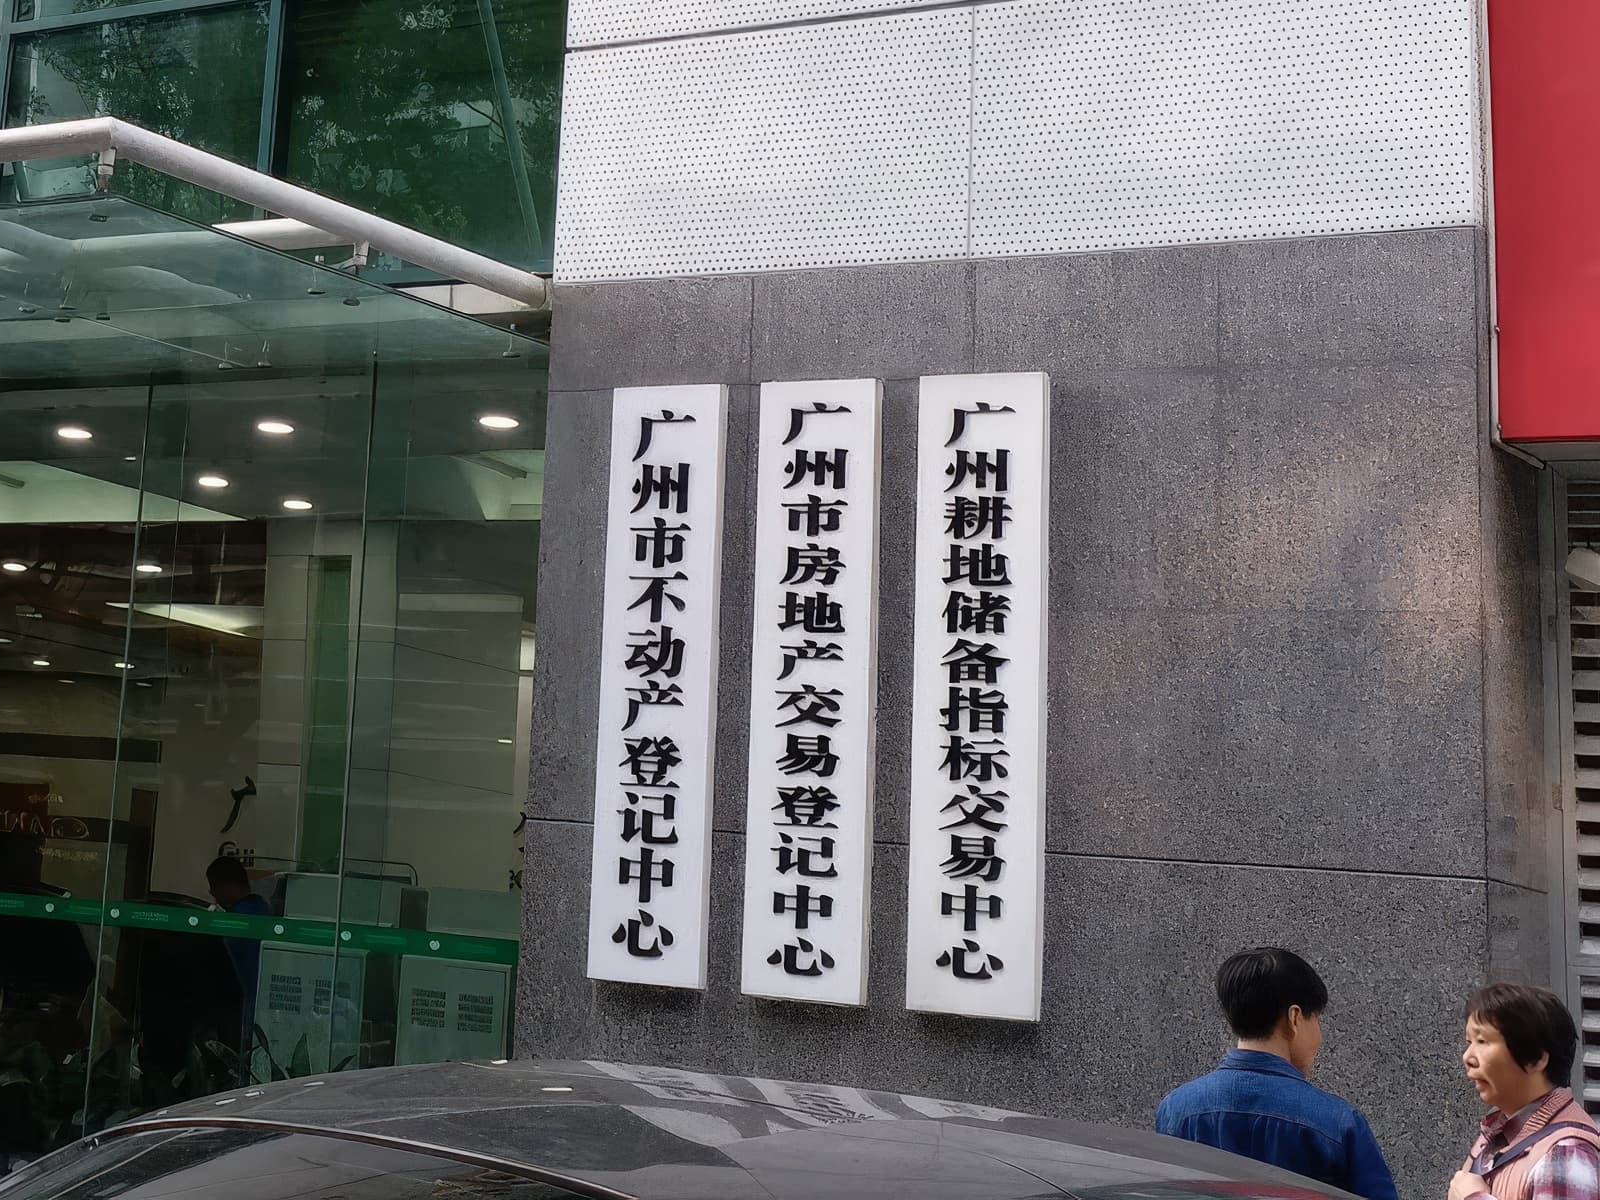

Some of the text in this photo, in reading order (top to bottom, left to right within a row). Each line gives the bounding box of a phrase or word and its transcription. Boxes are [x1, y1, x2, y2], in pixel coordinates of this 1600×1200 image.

[610, 408, 696, 960] 广州市不动产登记中心
[766, 401, 852, 978] 广州市房地产交易登记中心
[934, 401, 1016, 981] 广州耕地储备指标交易中心
